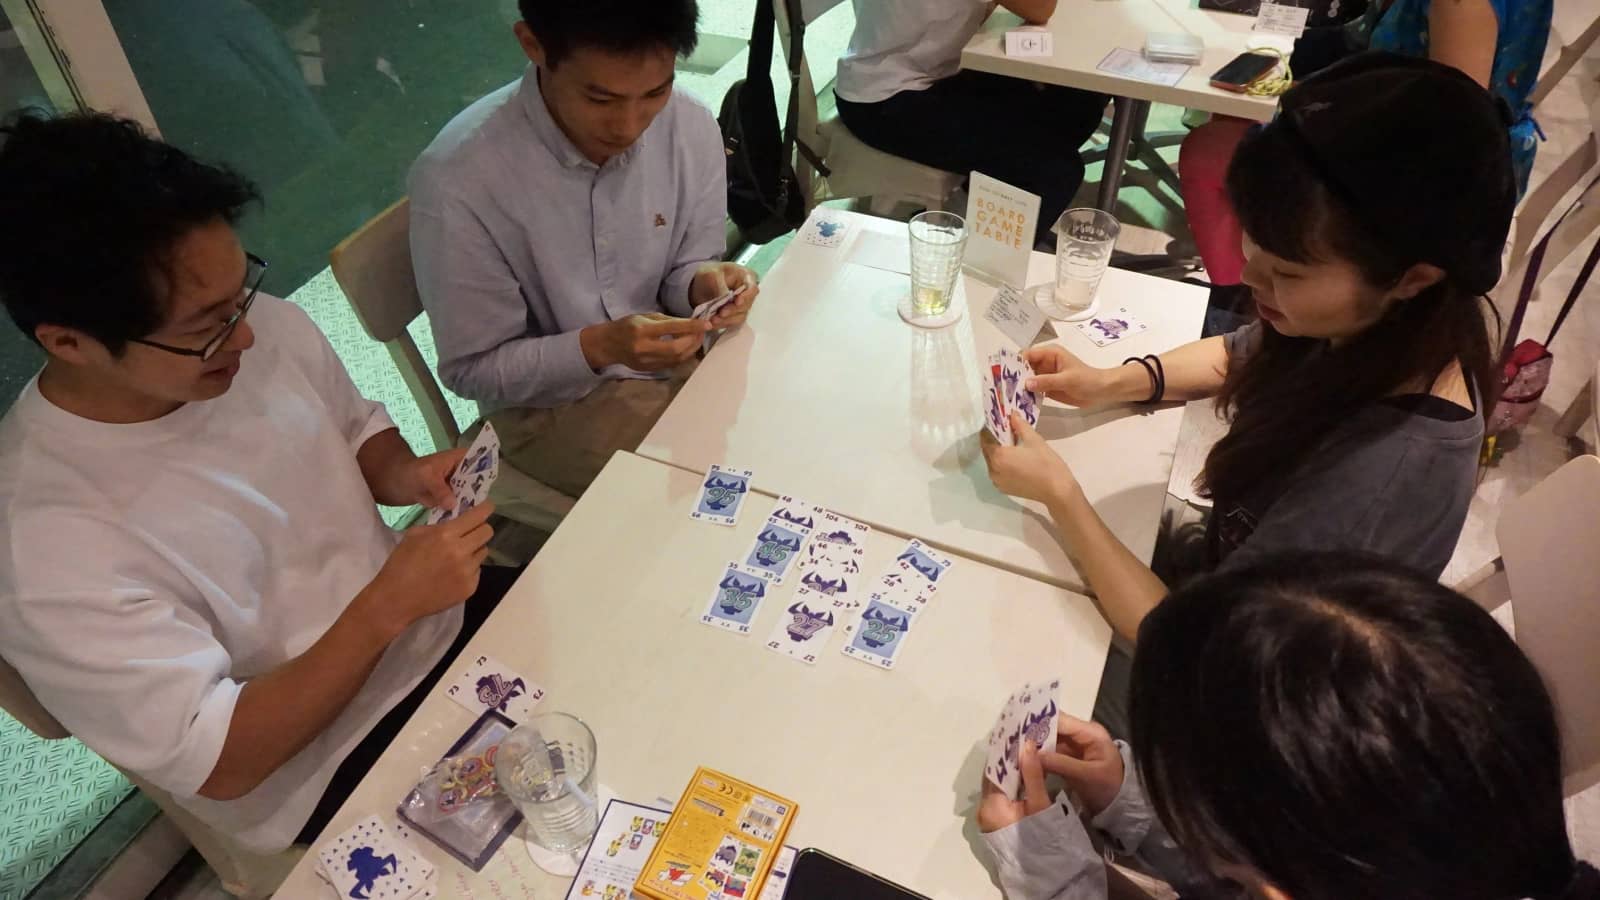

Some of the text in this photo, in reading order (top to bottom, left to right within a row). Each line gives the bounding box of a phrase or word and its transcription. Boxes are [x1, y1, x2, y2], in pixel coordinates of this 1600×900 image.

[976, 197, 1026, 225] BOARD
[976, 210, 1023, 237] GAME
[975, 222, 1022, 250] TABLE
[708, 486, 739, 506] 95
[758, 540, 792, 562] 45
[720, 587, 757, 611] 35
[786, 612, 828, 641] 27
[862, 620, 902, 644] 25
